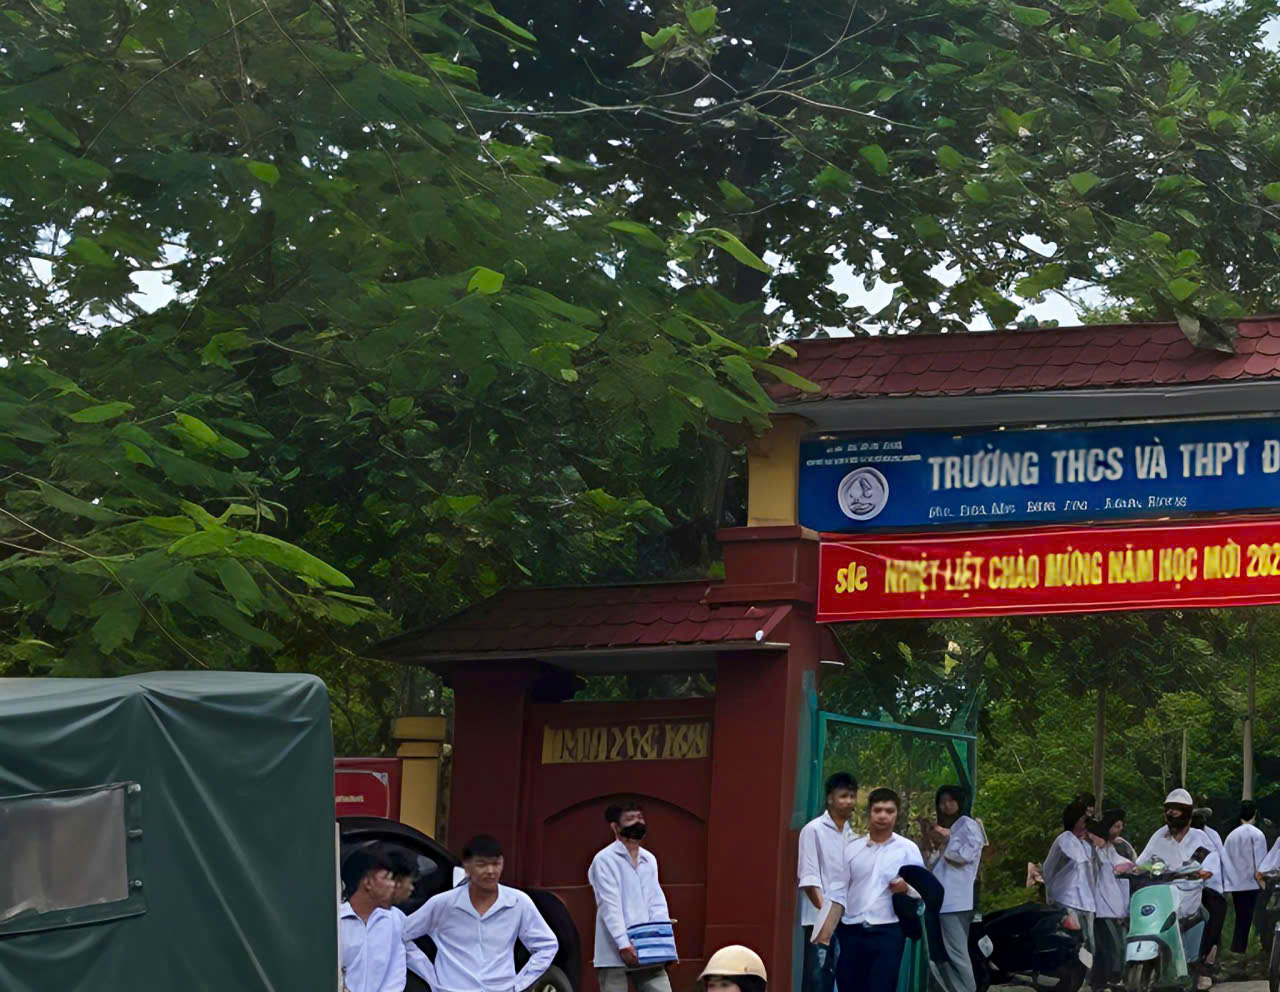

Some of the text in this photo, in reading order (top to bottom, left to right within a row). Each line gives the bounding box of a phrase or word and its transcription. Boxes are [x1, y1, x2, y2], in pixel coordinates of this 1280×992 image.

[927, 442, 1039, 491] TRƯỜNG
[1051, 447, 1124, 485] THCS
[1134, 436, 1168, 480] VÀ
[1179, 441, 1250, 478] THPT
[1158, 547, 1198, 590] HỌC
